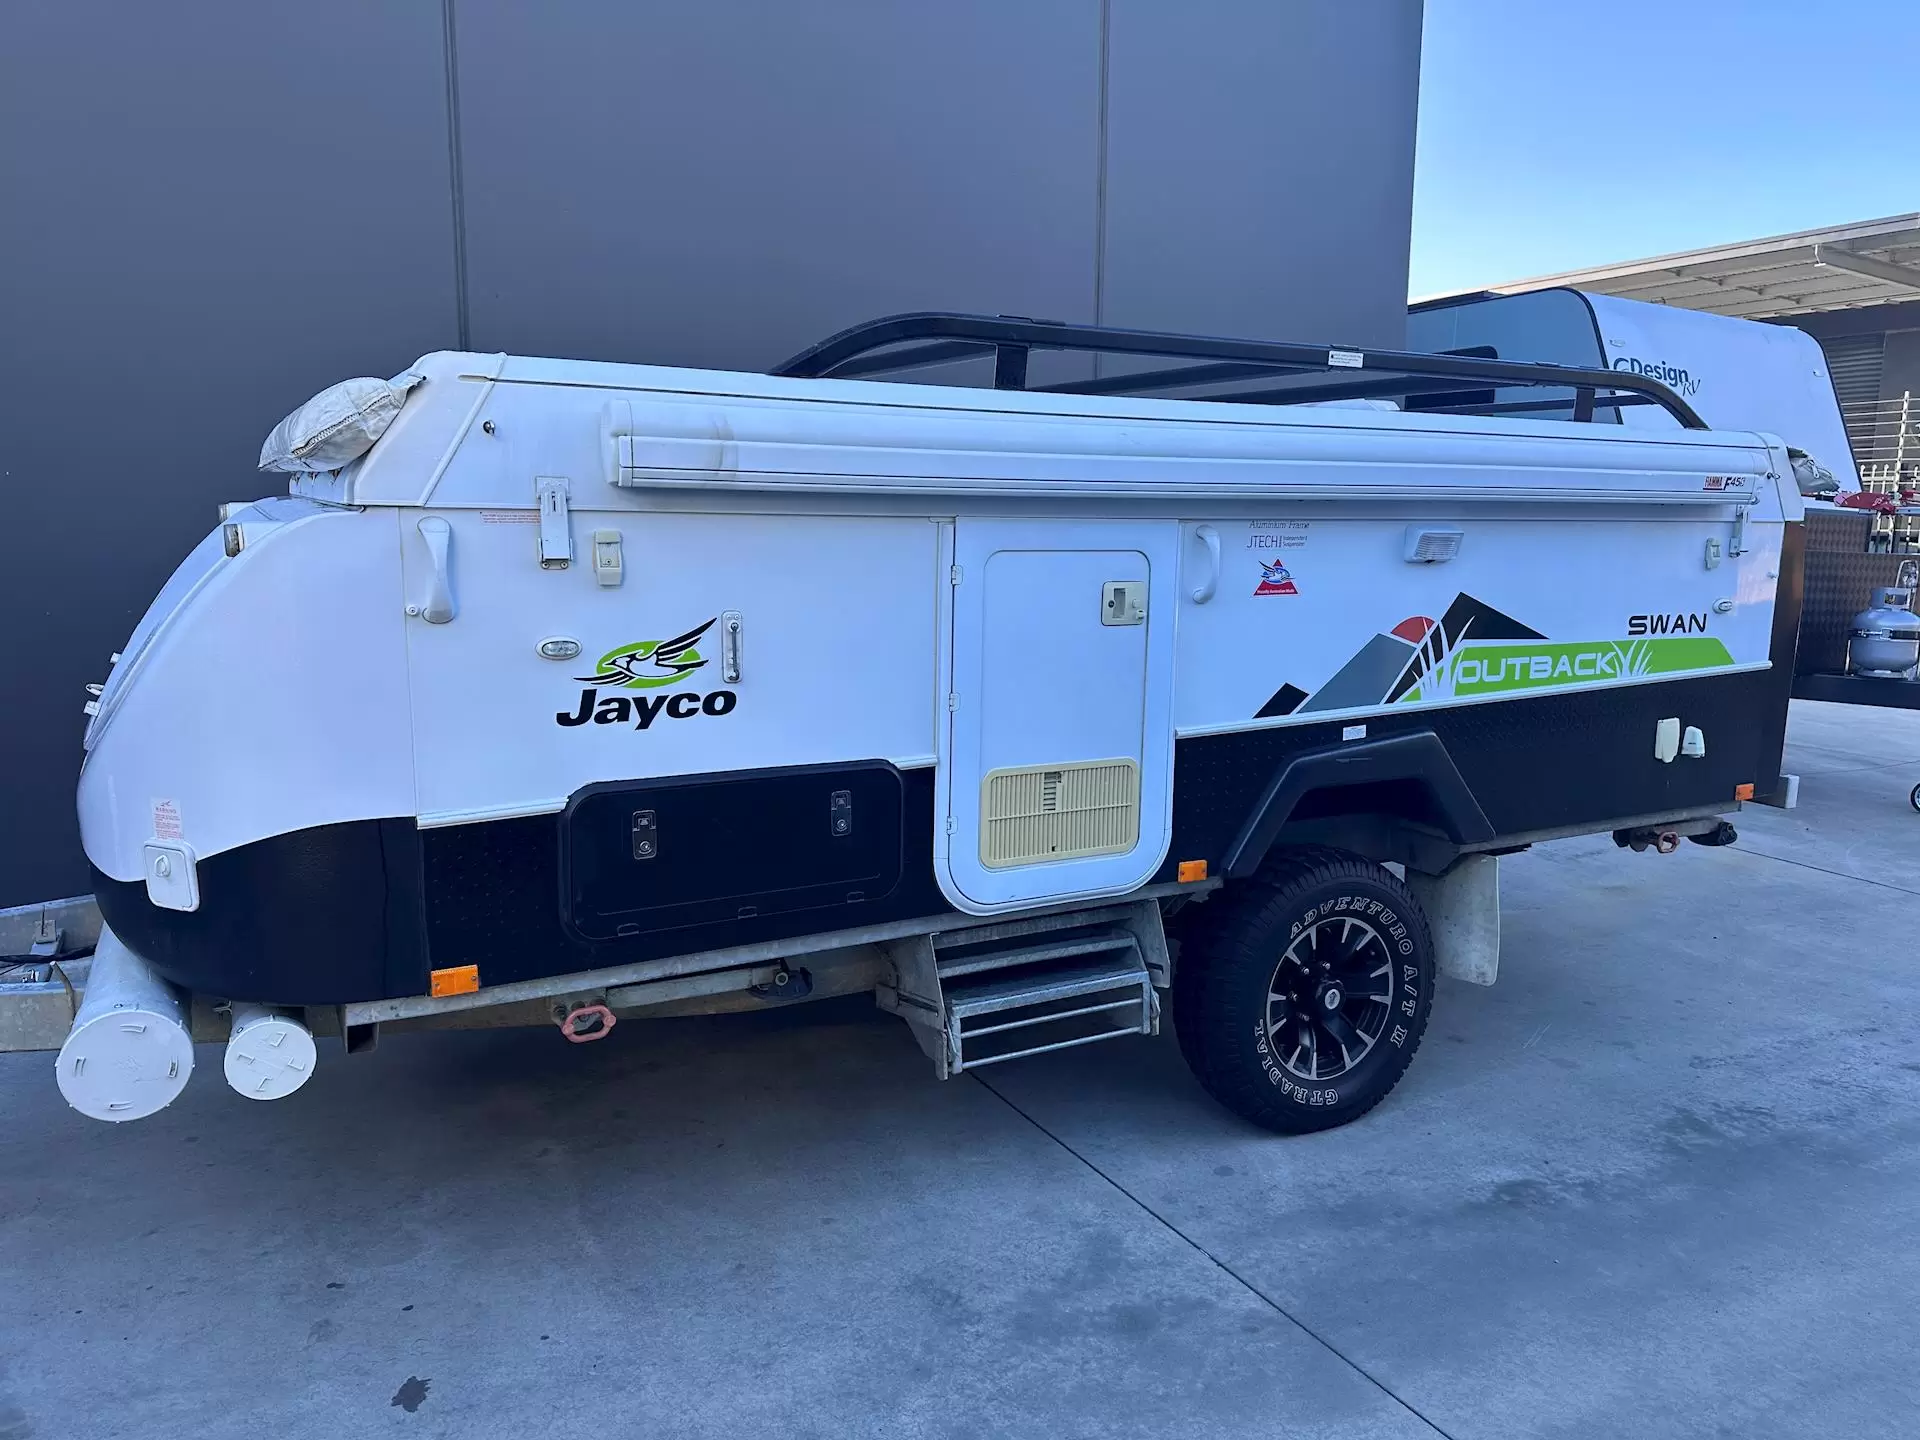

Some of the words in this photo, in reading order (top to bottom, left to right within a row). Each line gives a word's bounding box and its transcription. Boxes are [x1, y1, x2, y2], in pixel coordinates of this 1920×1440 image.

[1682, 379, 1701, 396] RV
[1288, 519, 1310, 529] Frame
[1628, 613, 1707, 636] SWAN
[1457, 651, 1617, 684] OUTBACK
[556, 688, 738, 731] Jayco
[1290, 896, 1414, 956] ADVENTURO
[1402, 964, 1418, 1017] A/T
